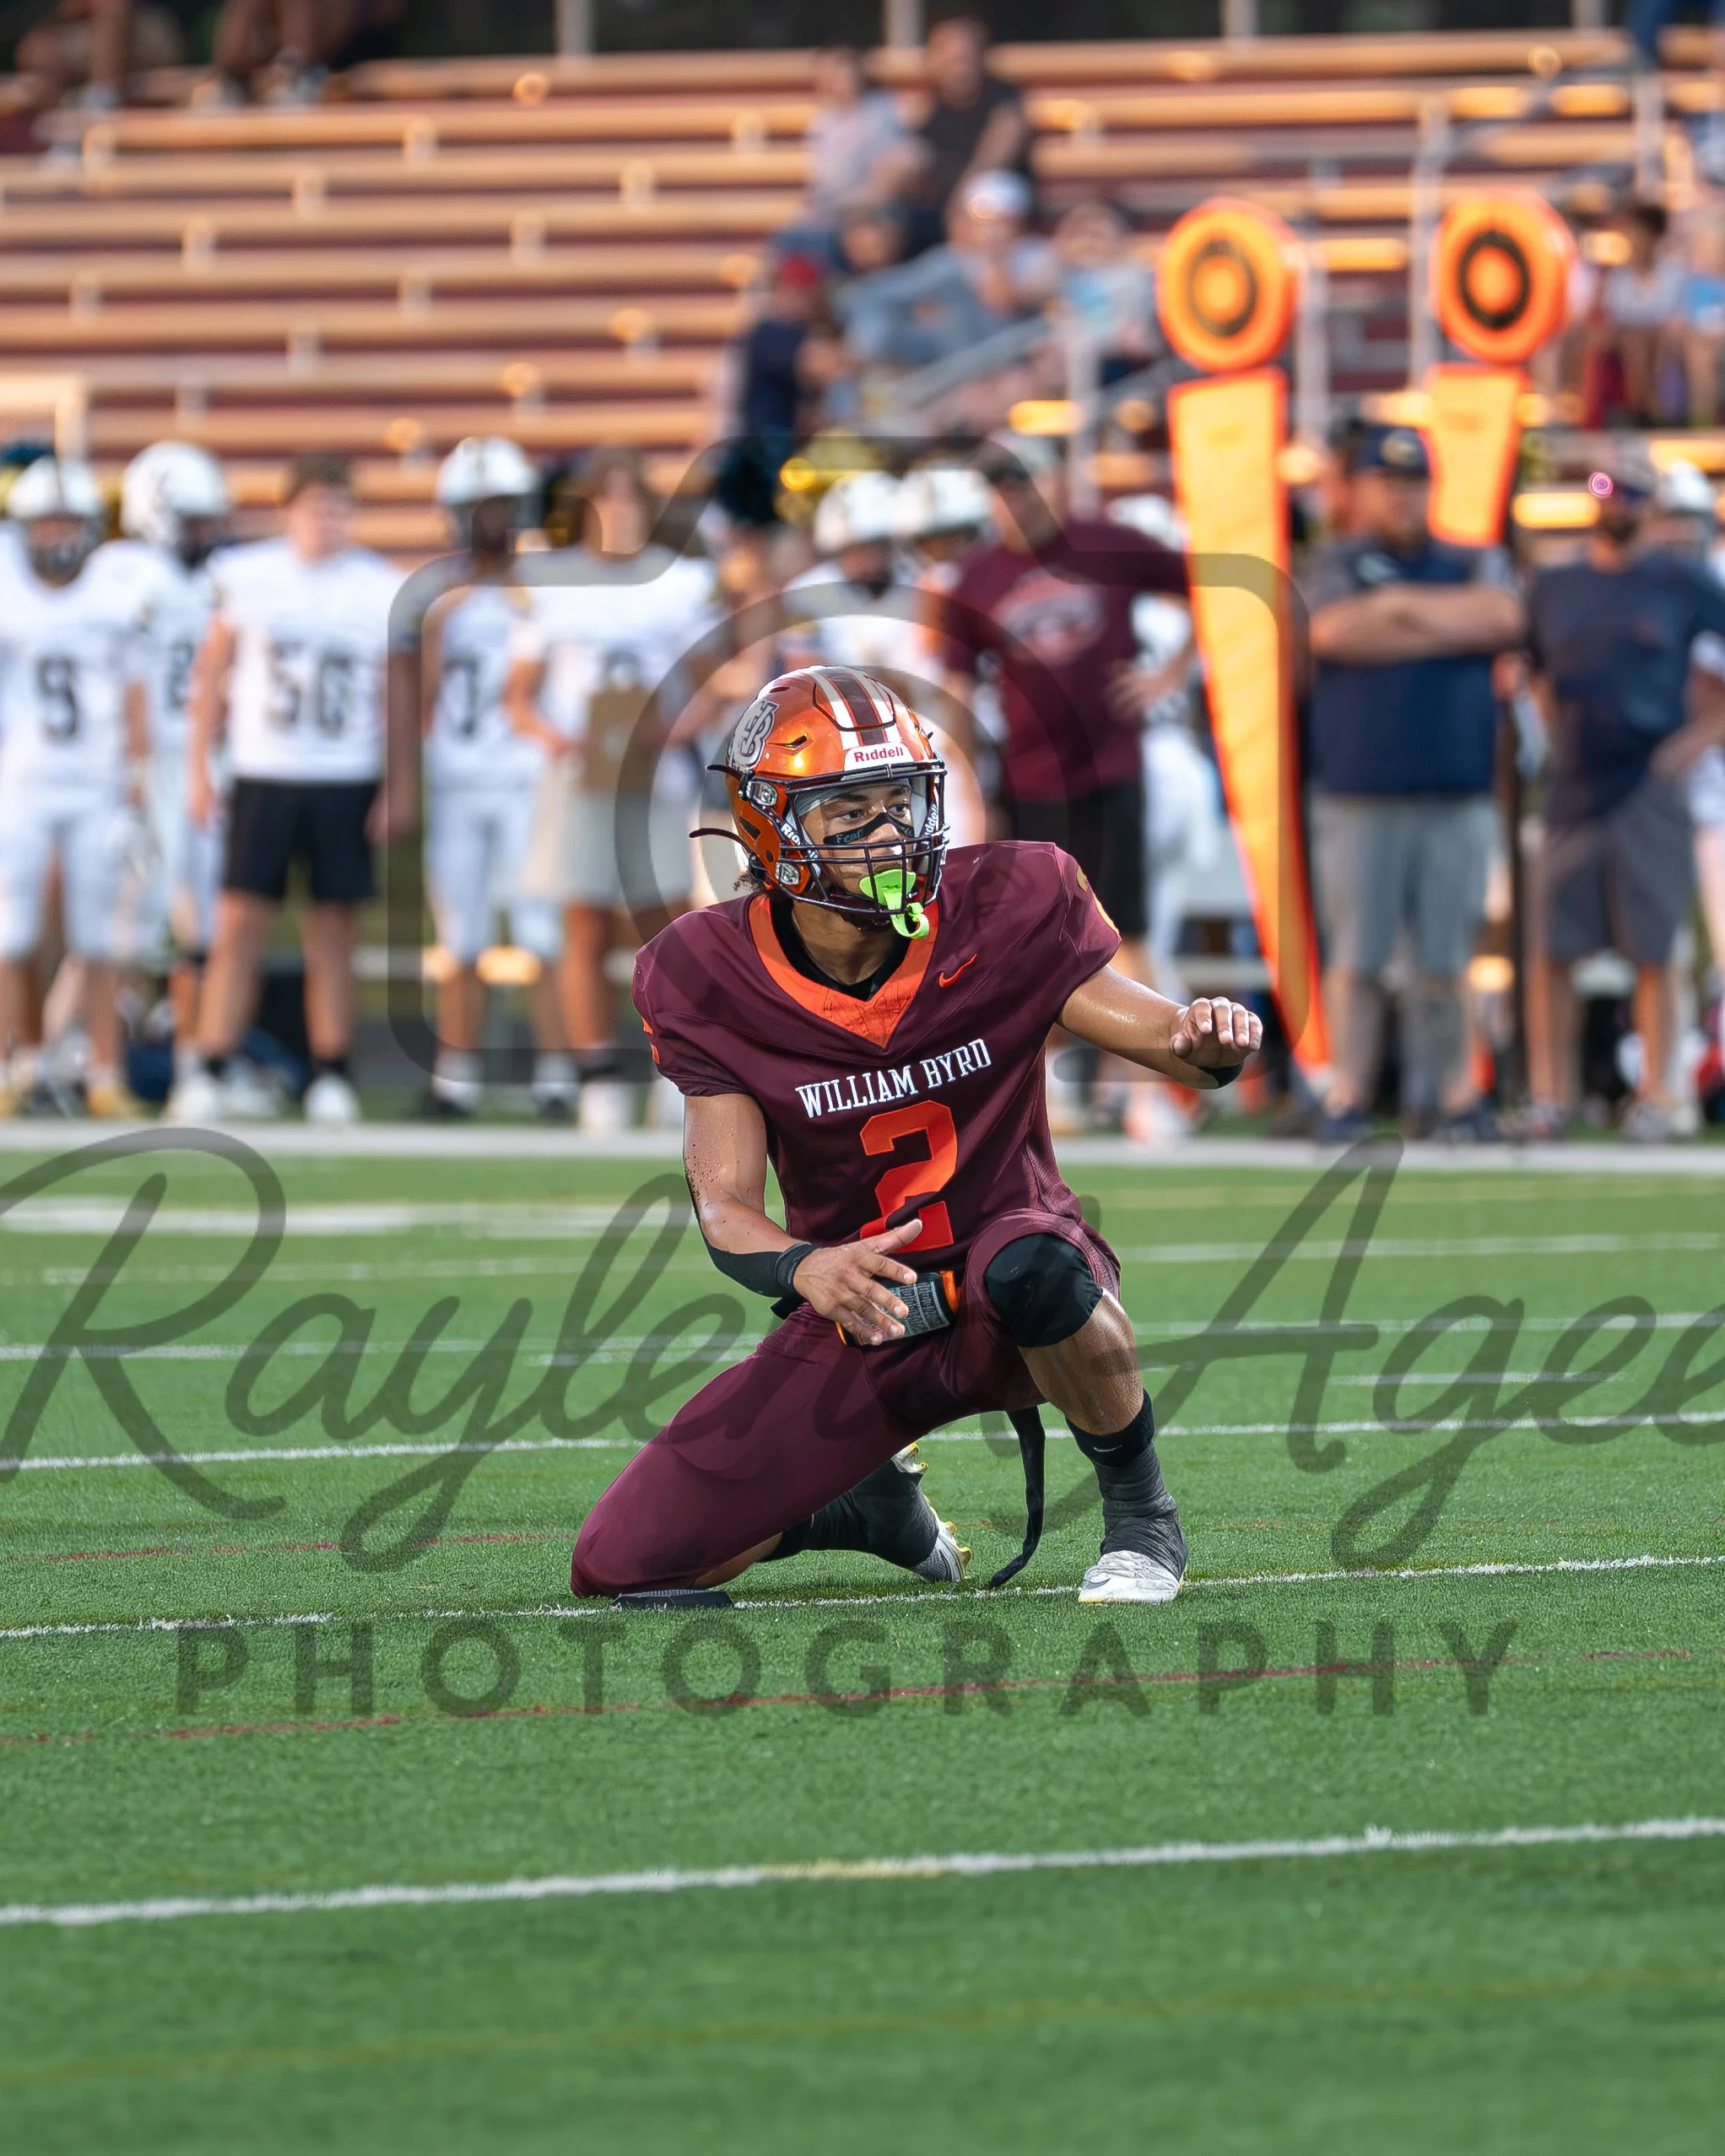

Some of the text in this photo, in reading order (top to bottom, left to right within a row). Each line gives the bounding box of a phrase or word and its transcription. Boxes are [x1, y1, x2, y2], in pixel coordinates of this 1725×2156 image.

[853, 746, 904, 763] Riddell
[794, 1038, 992, 1119] WILLIAM BYRD
[859, 1100, 958, 1254] 2
